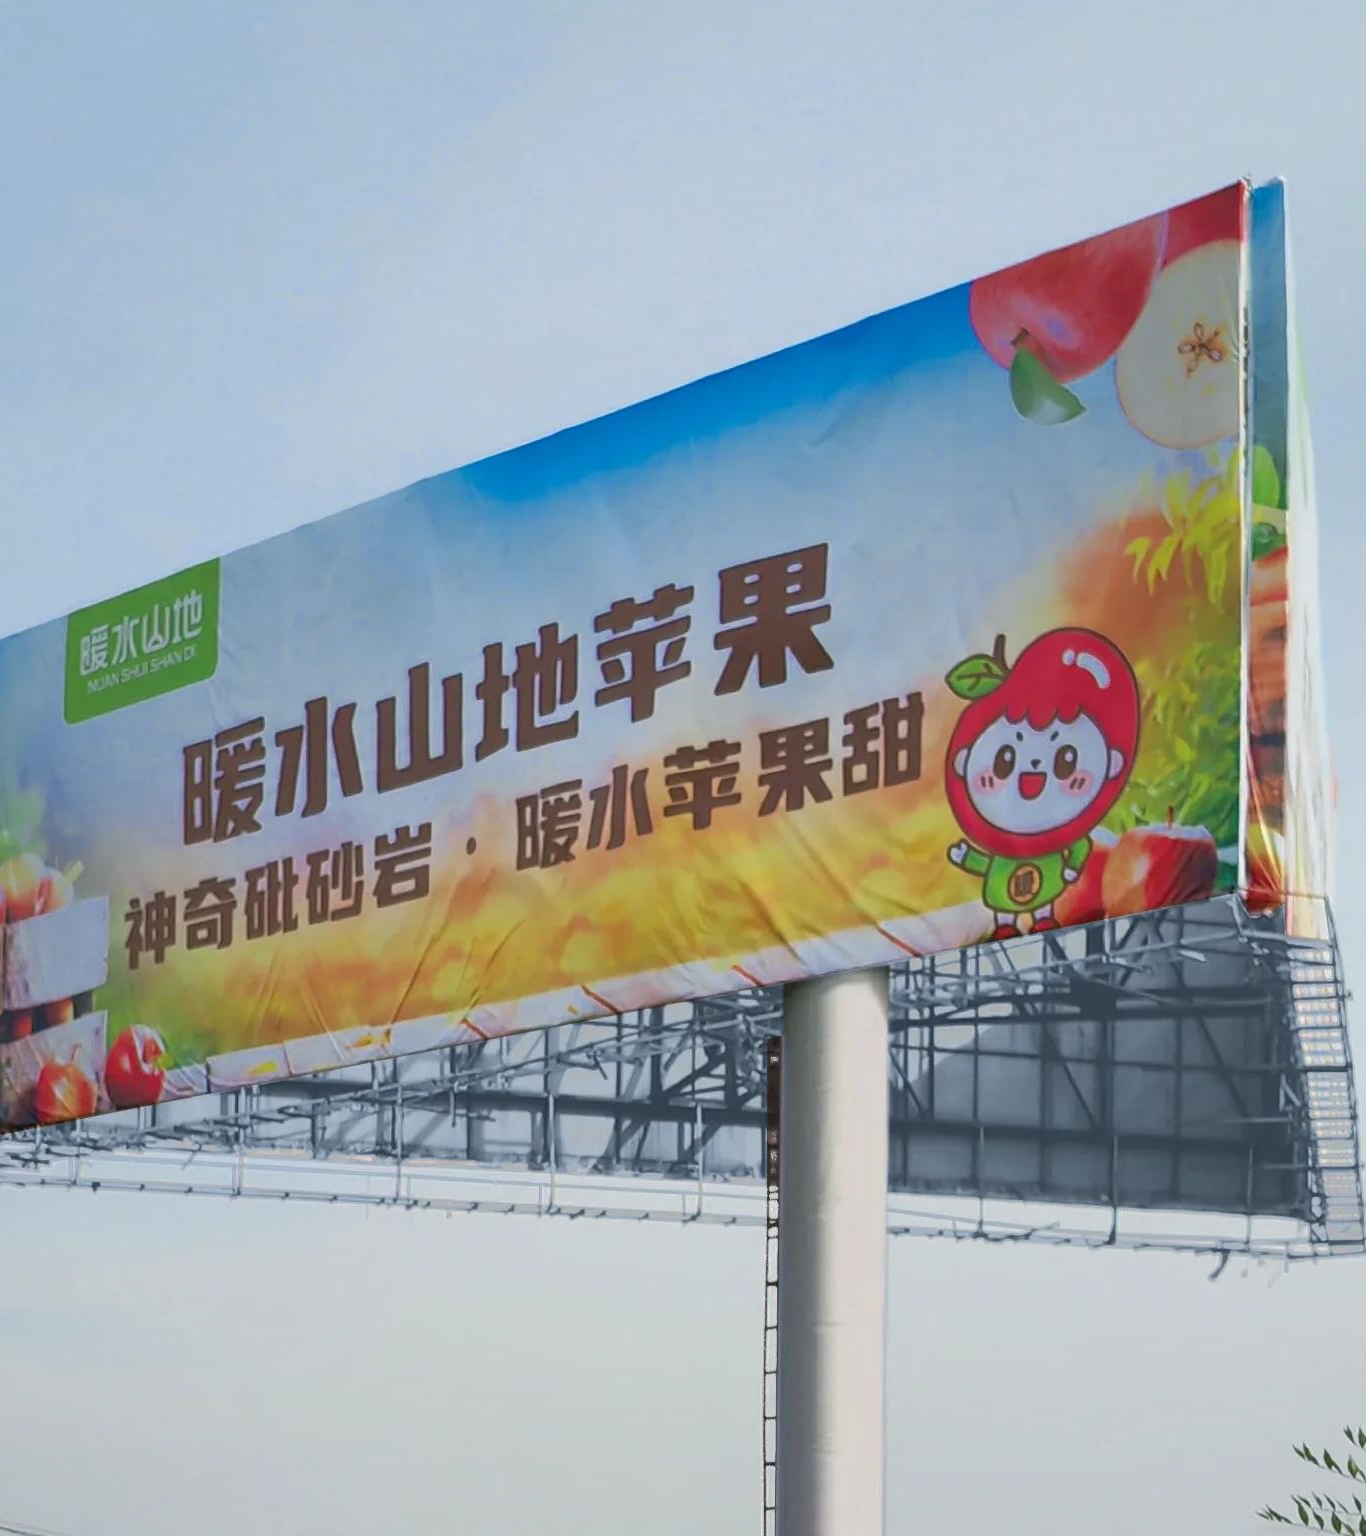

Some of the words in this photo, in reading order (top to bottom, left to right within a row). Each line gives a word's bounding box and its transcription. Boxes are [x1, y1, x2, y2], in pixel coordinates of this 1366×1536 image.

[80, 589, 203, 676] 暖水山地
[87, 672, 120, 694] NUAN
[121, 662, 148, 683] SHUI
[150, 649, 182, 673] SHAN
[182, 541, 835, 846] 暖水山地苹果
